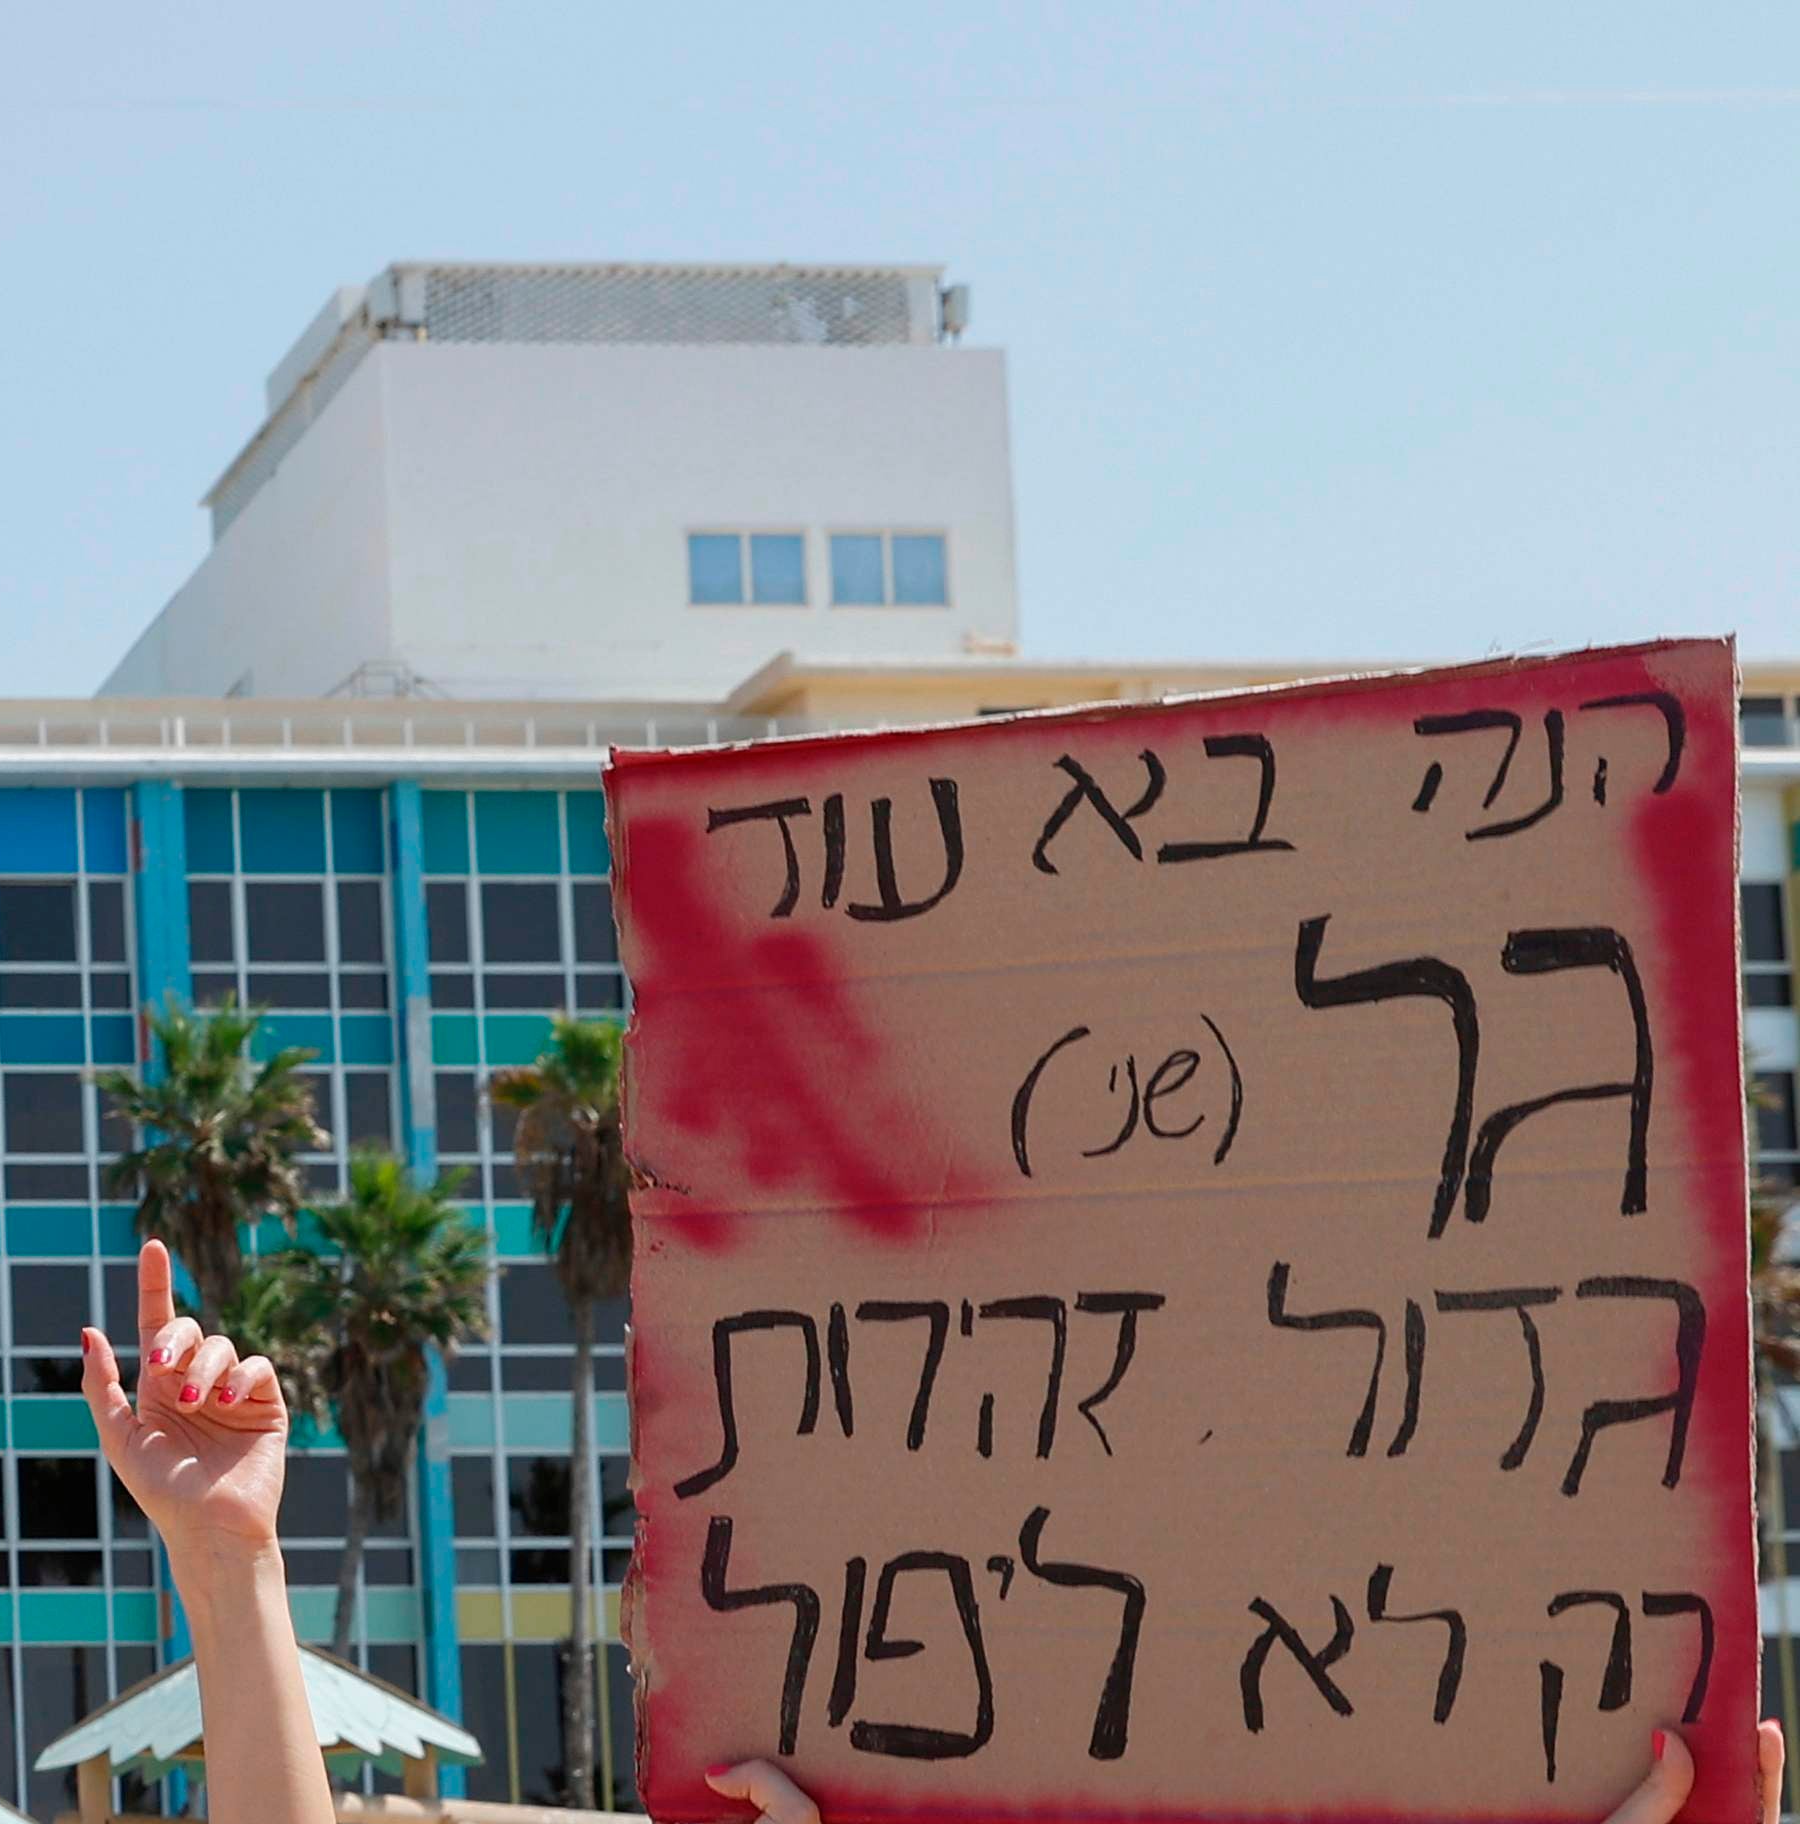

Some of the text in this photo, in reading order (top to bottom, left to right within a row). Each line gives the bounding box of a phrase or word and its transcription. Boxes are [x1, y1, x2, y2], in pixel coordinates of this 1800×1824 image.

[706, 693, 1686, 922] הנה בא עוד
[1295, 914, 1654, 1240] גל
[674, 1290, 1168, 1500] זהירות
[701, 1505, 1716, 1785] רק לא ליפול
